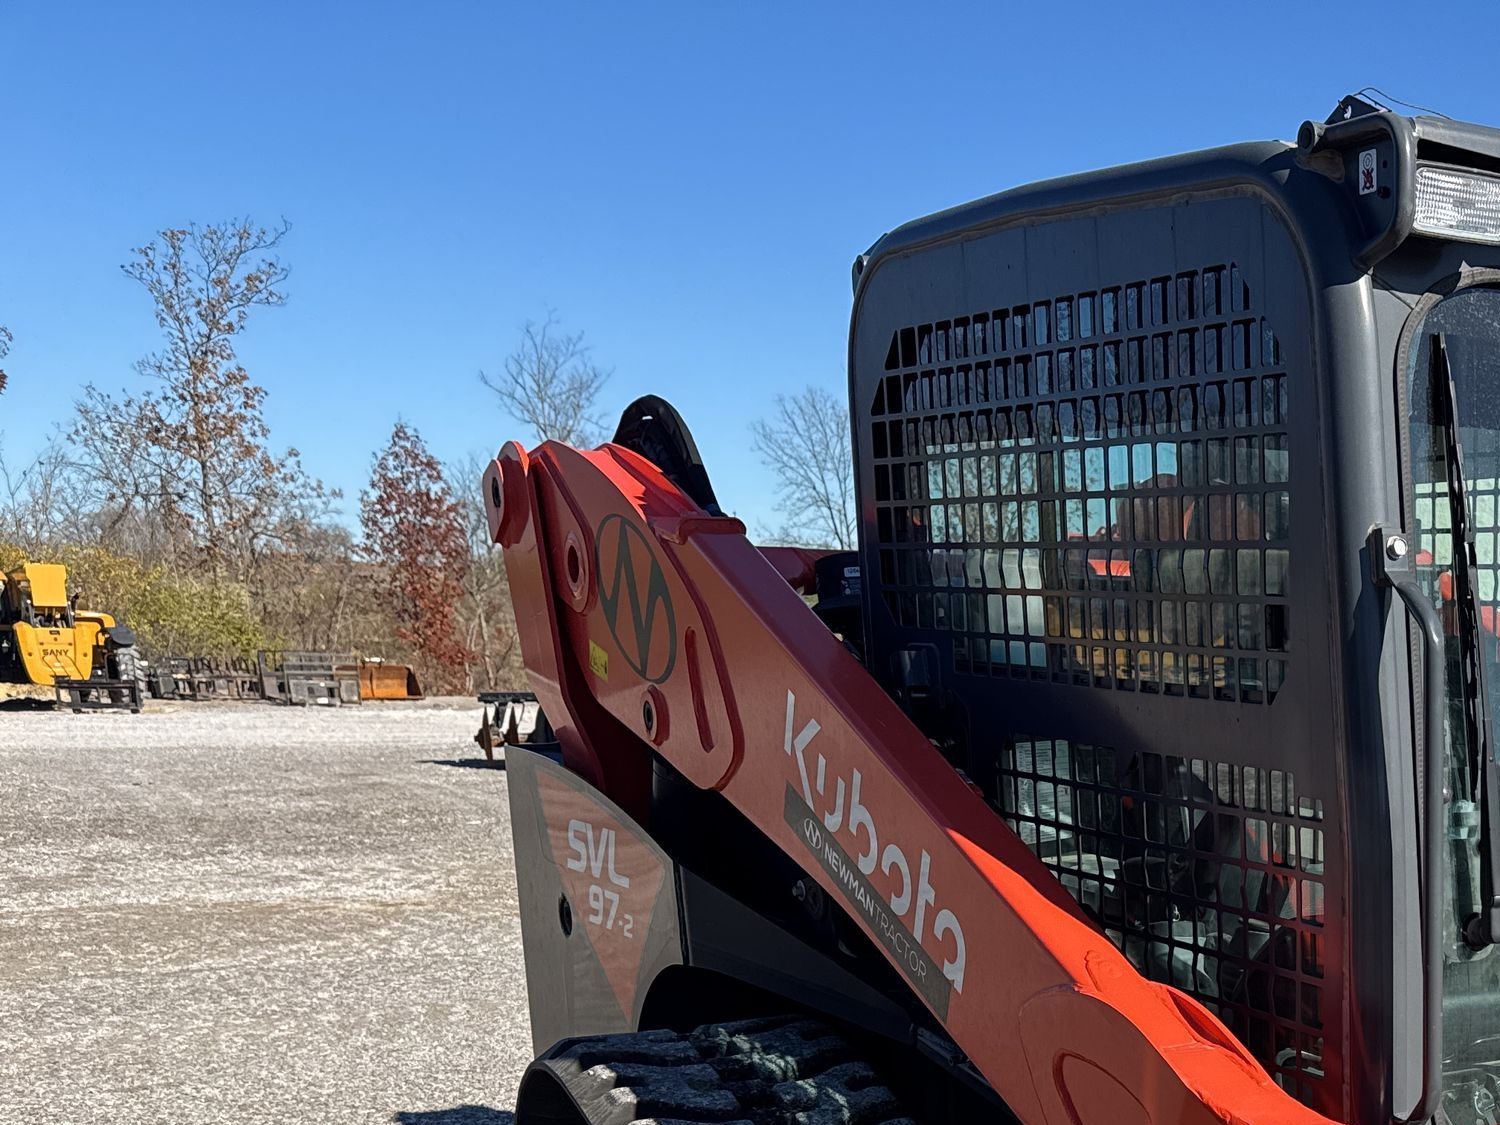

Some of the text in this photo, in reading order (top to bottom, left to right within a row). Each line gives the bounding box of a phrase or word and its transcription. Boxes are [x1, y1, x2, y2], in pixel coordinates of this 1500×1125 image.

[567, 819, 630, 889] SVL
[783, 689, 966, 995] Kubota
[588, 884, 634, 939] 97-2
